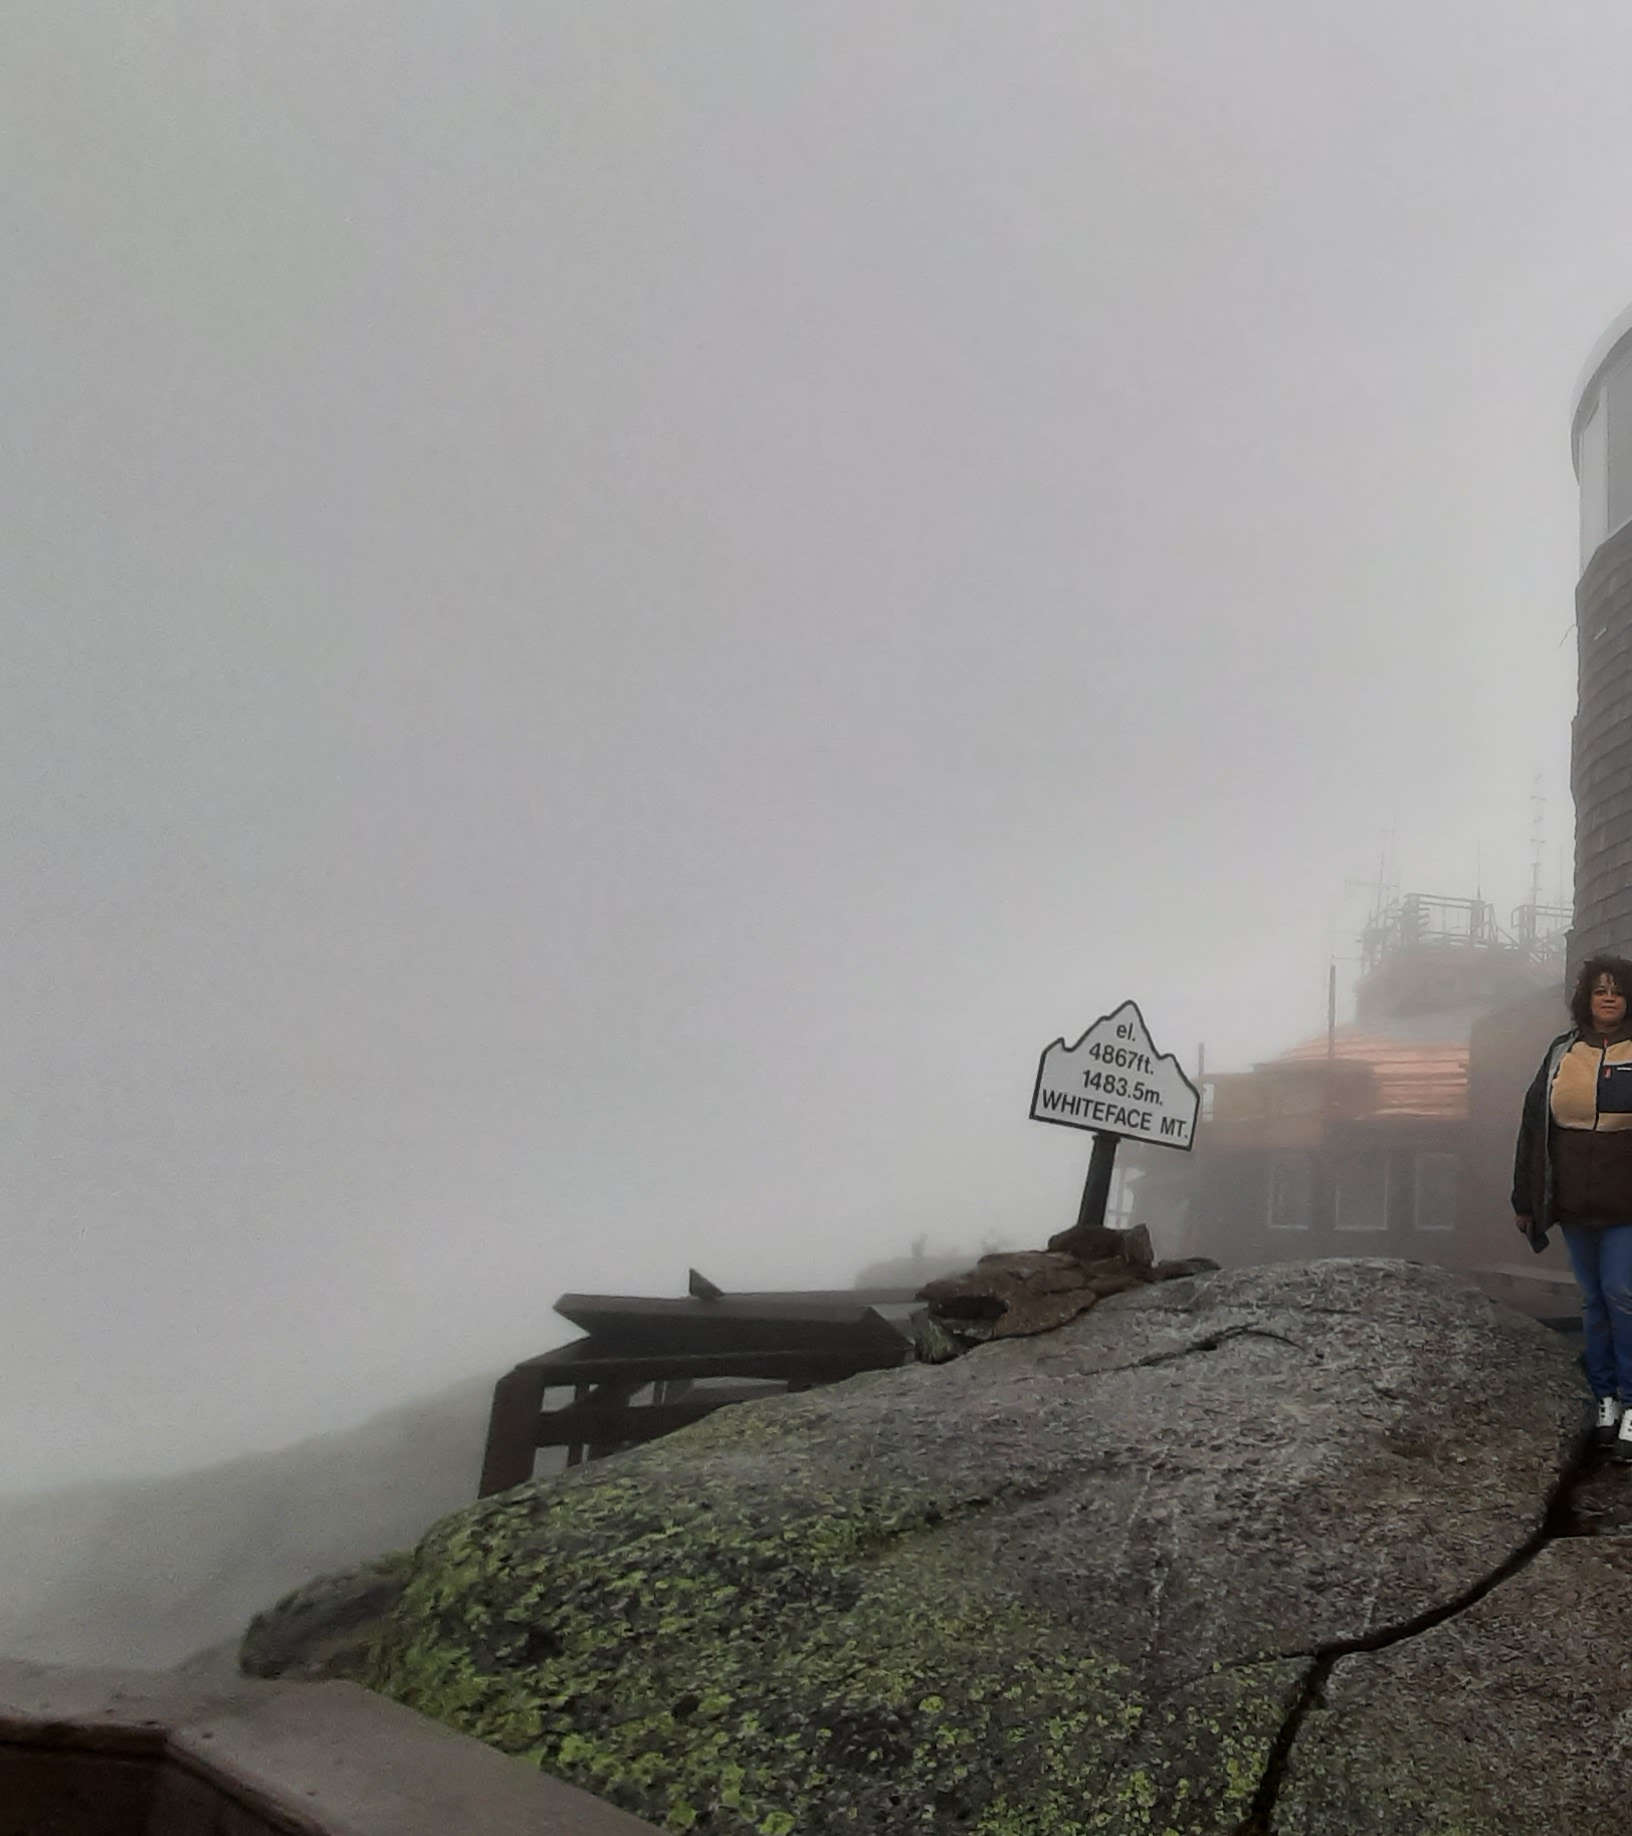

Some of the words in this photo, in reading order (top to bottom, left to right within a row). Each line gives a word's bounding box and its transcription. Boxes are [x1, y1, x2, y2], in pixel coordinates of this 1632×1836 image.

[1116, 1022, 1136, 1042] el.
[1089, 1042, 1154, 1075] 4867ft.
[1082, 1069, 1163, 1106] 1483.5m.
[1042, 1089, 1153, 1131] WHITEFACE
[1160, 1116, 1189, 1139] MT.
